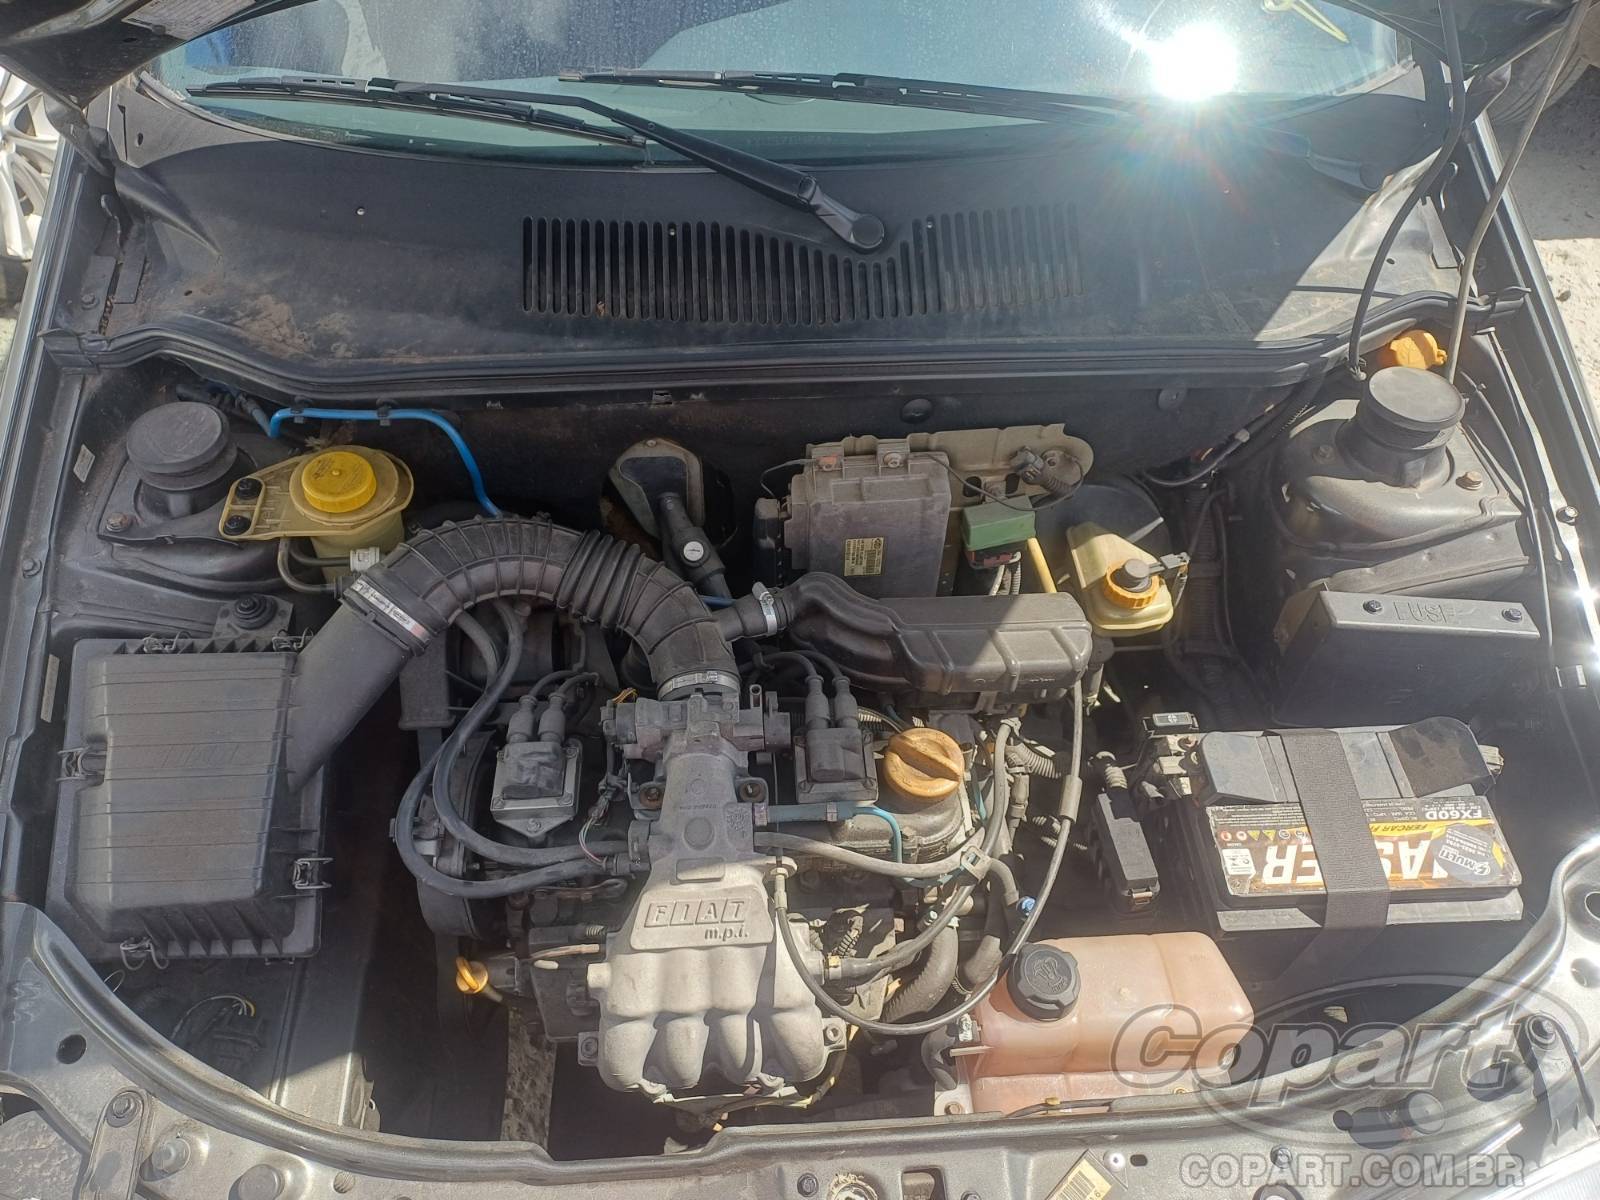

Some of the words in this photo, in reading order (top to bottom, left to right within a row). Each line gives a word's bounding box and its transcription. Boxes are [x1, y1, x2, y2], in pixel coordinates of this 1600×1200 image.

[1425, 809, 1483, 821] FX60D
[1382, 823, 1428, 833] FERCAR
[1440, 849, 1476, 870] MULTI
[647, 900, 745, 927] FIAT
[704, 926, 749, 942] m.p.i.
